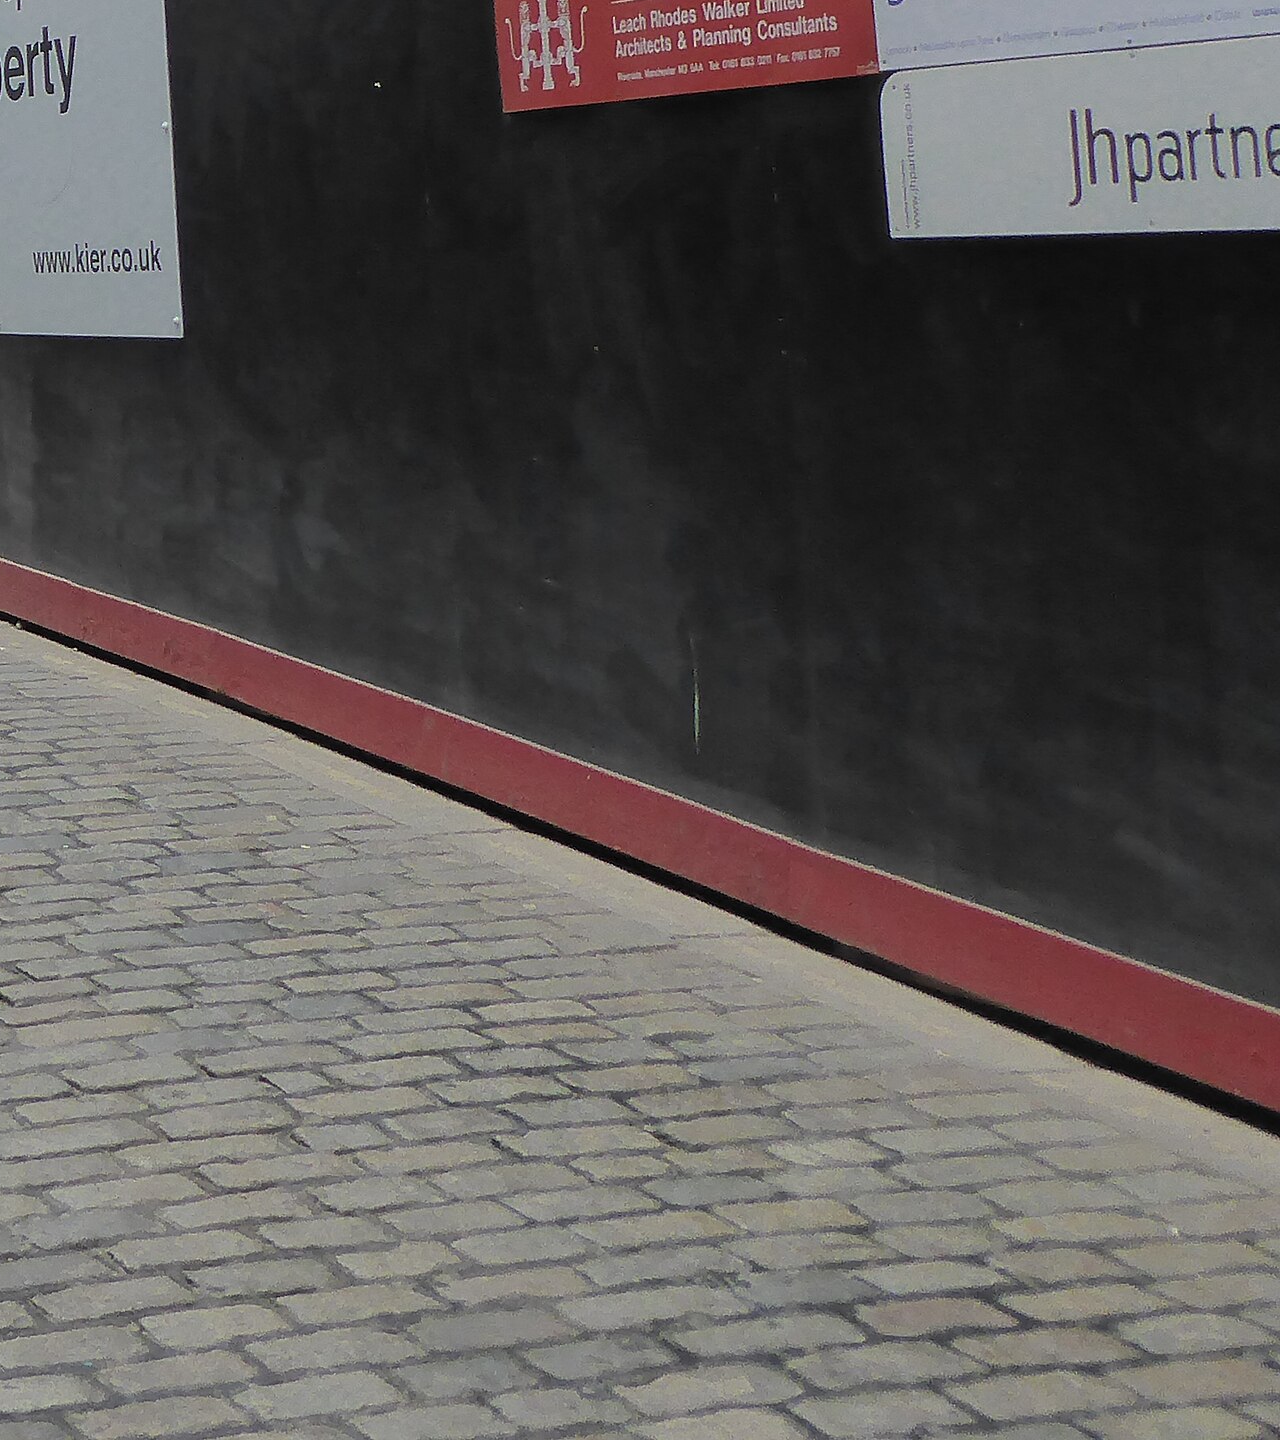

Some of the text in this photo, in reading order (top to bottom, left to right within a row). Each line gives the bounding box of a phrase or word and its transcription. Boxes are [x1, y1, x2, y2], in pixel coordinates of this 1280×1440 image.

[612, 14, 646, 35] Leach
[650, 6, 697, 29] Rhodes
[702, 0, 750, 22] Walker
[615, 11, 838, 58] Architects & Planning Consultants
[33, 240, 162, 274] www.kier.co.uk
